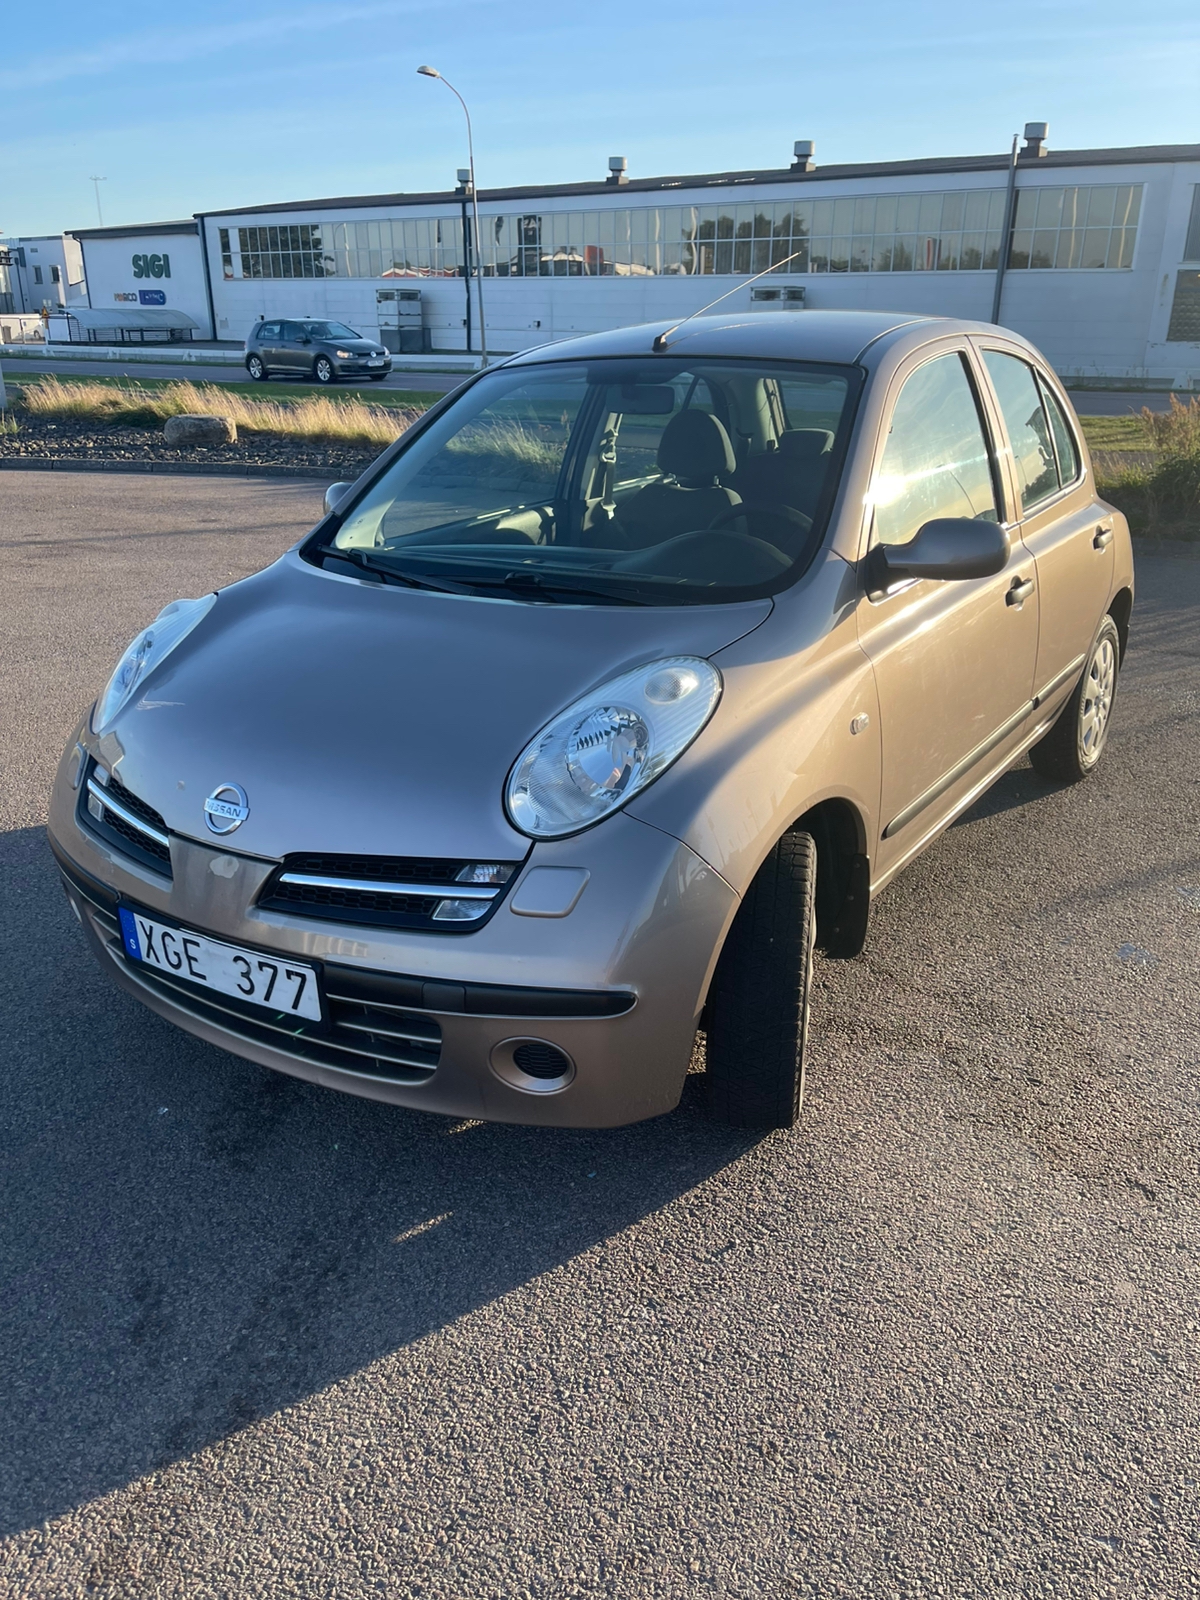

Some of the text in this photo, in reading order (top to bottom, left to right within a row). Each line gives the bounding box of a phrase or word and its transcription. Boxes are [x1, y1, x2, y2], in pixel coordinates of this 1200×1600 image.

[132, 253, 171, 279] SIGI
[206, 800, 242, 818] NISSAN
[129, 938, 137, 950] S
[139, 920, 307, 1011] XGE 377
